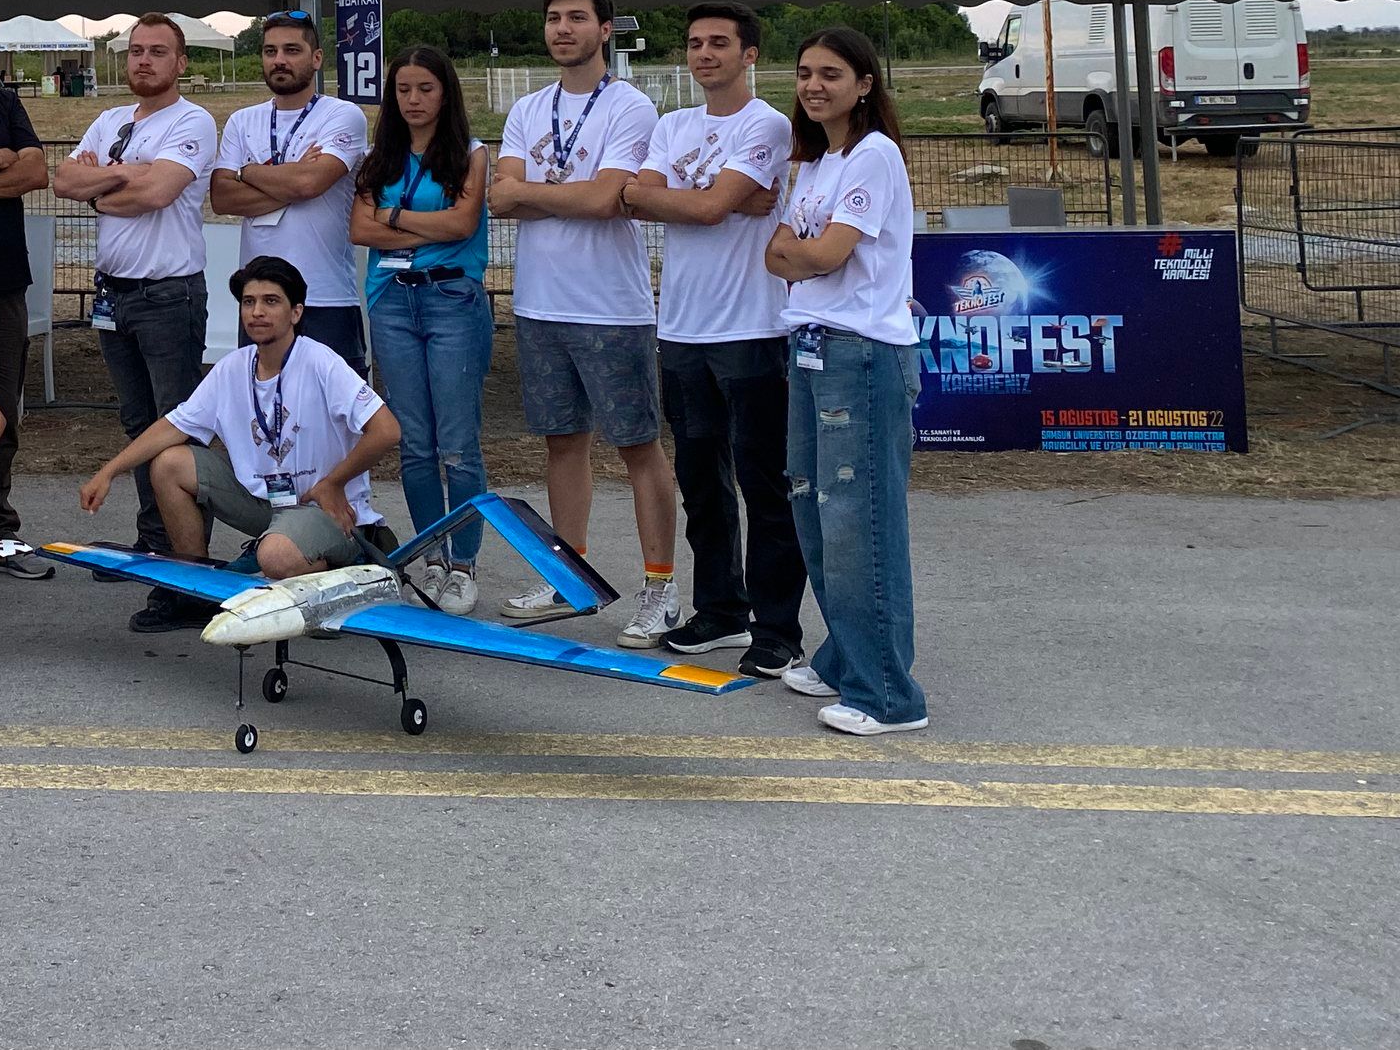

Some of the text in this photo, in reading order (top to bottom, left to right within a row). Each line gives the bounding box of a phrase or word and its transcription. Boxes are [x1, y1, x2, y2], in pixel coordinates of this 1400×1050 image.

[343, 52, 377, 97] 12
[954, 292, 1005, 312] TEKNOFEST
[912, 315, 1124, 374] KNOFEST
[1040, 410, 1055, 426] 15
[1059, 409, 1119, 426] AĞUSTOS
[1128, 410, 1143, 426] 21
[1090, 441, 1102, 451] VE
[1103, 441, 1127, 451] UZAY
